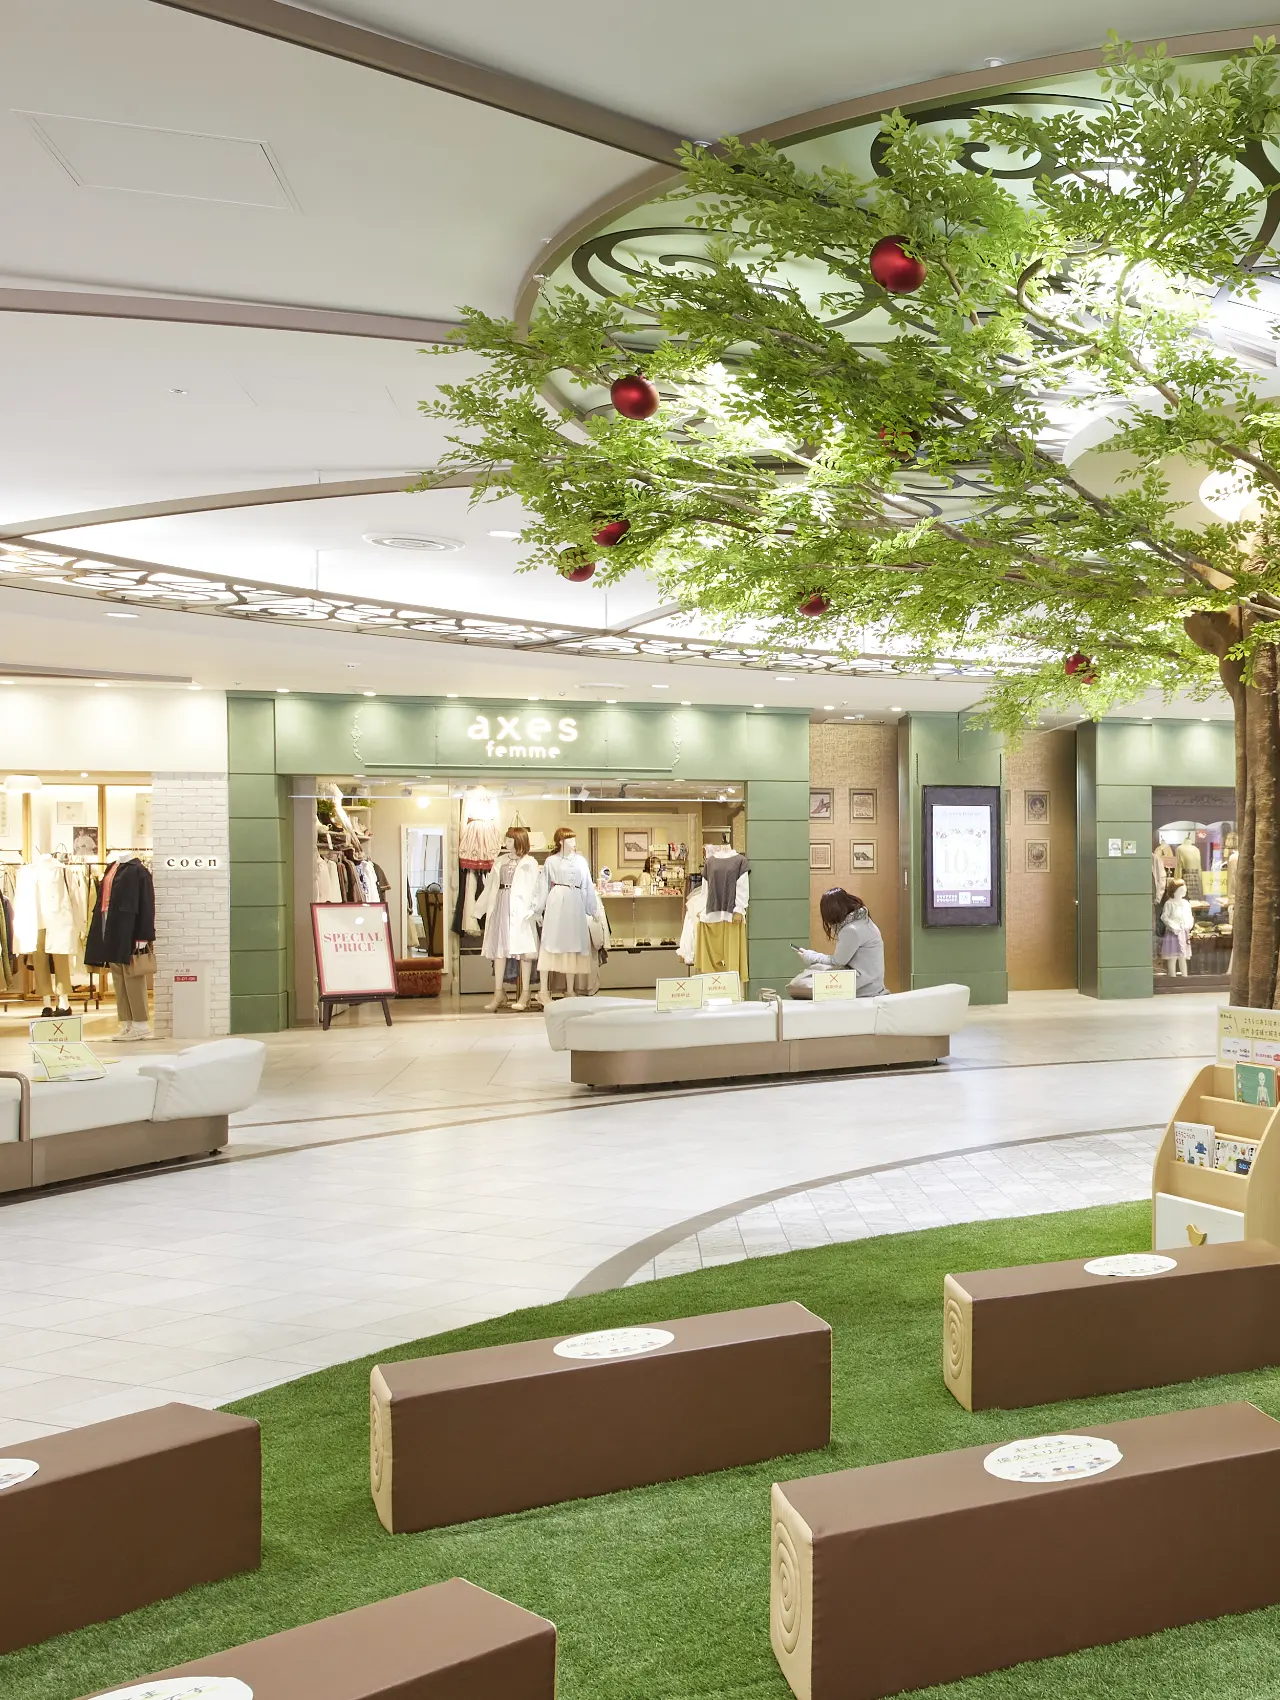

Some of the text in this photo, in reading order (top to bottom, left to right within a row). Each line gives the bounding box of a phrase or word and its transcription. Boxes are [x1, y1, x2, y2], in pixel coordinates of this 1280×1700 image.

[467, 715, 578, 742] axes
[486, 740, 561, 759] femme
[166, 858, 217, 867] coen
[323, 931, 384, 943] SPECIAL
[334, 942, 376, 953] PRICE
